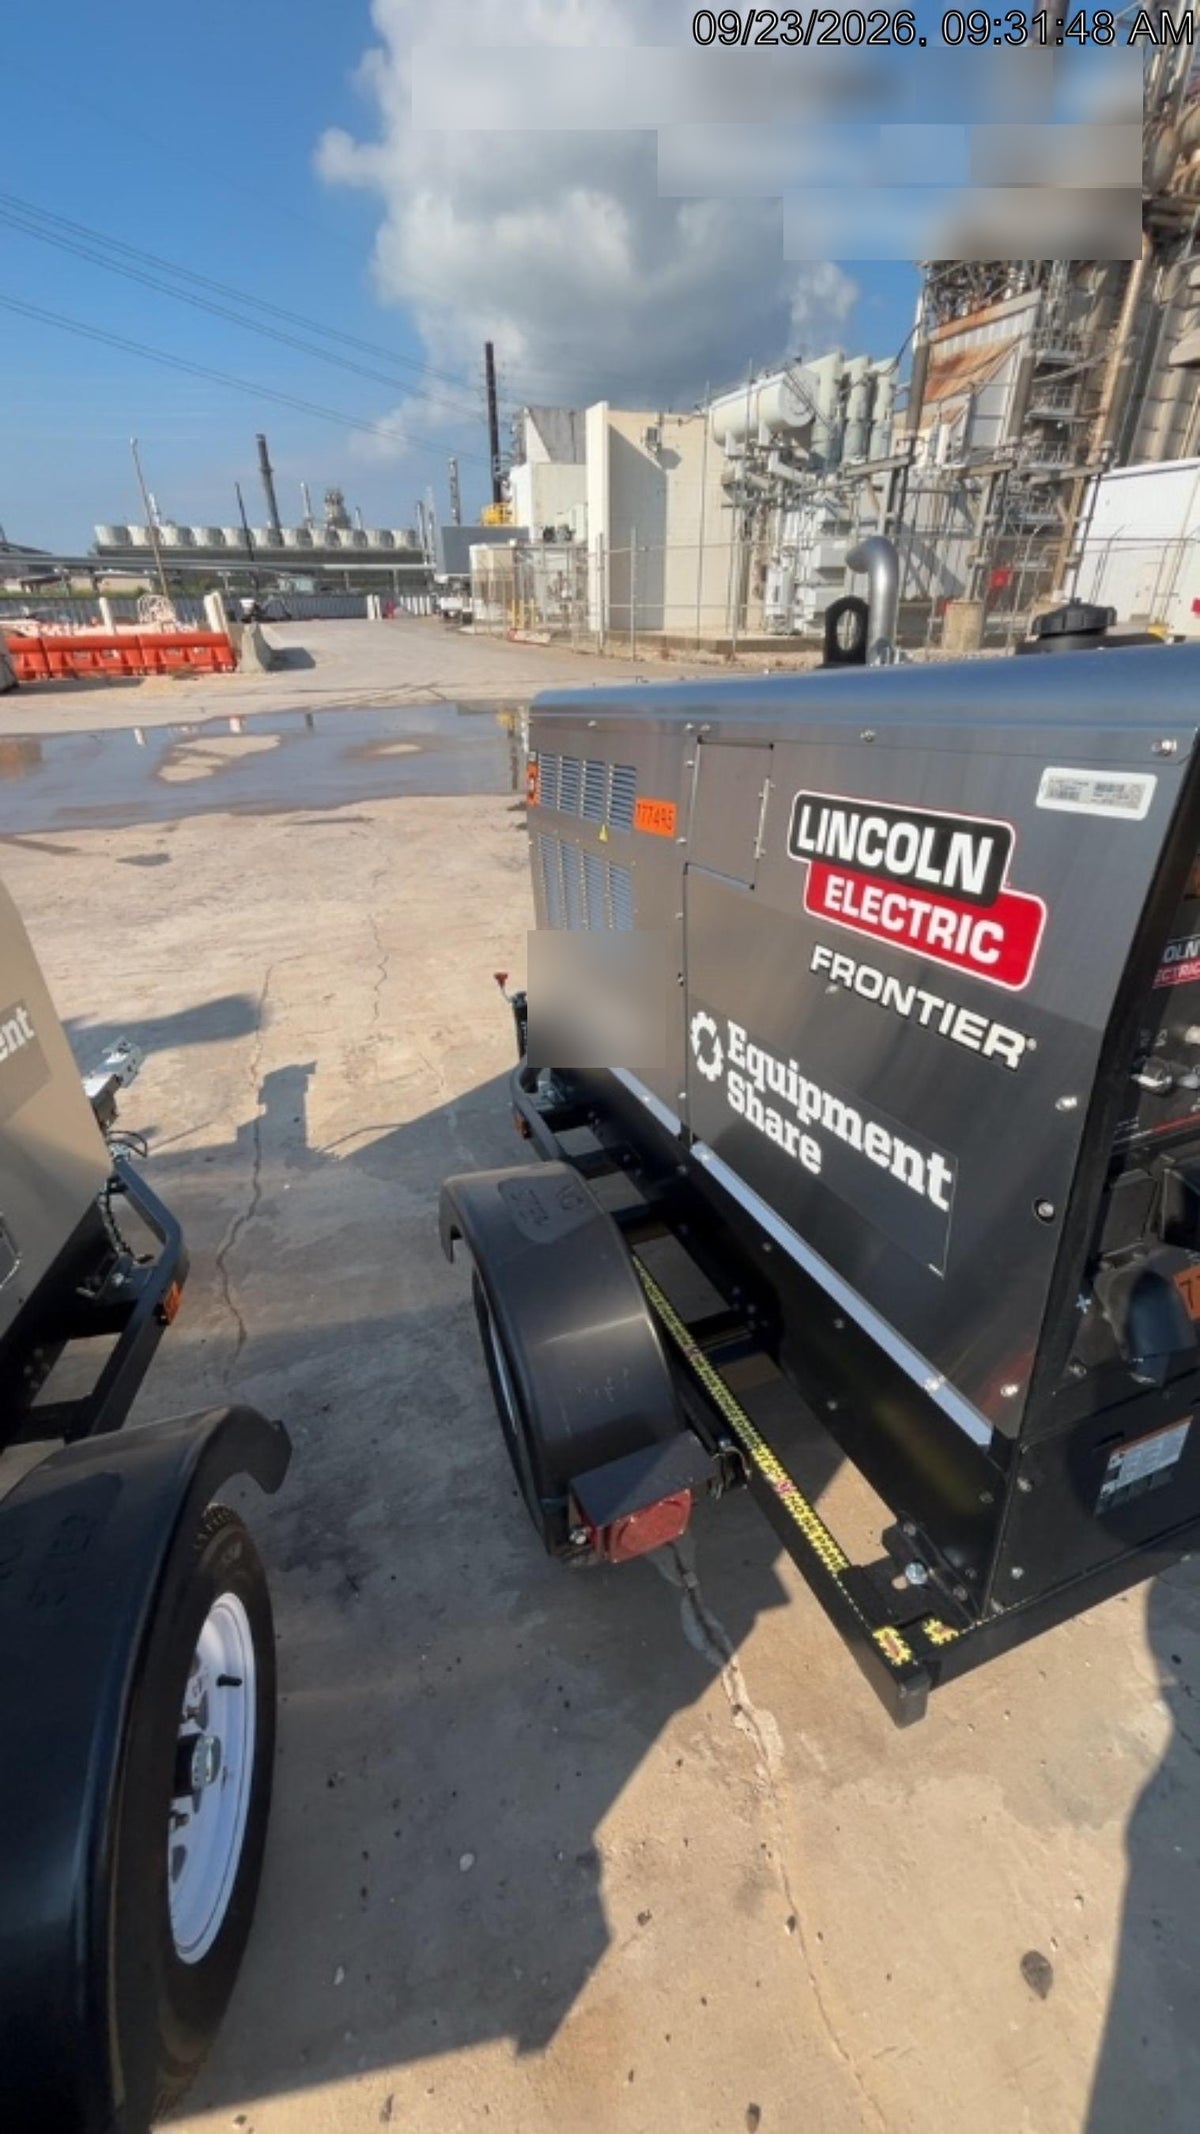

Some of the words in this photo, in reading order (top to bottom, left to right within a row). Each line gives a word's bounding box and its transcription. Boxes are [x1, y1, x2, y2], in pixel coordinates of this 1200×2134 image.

[796, 804, 994, 895] LINCOLN
[824, 875, 1004, 964] ELECTRIC
[727, 1019, 952, 1212] Equipment
[727, 1070, 822, 1175] Share
